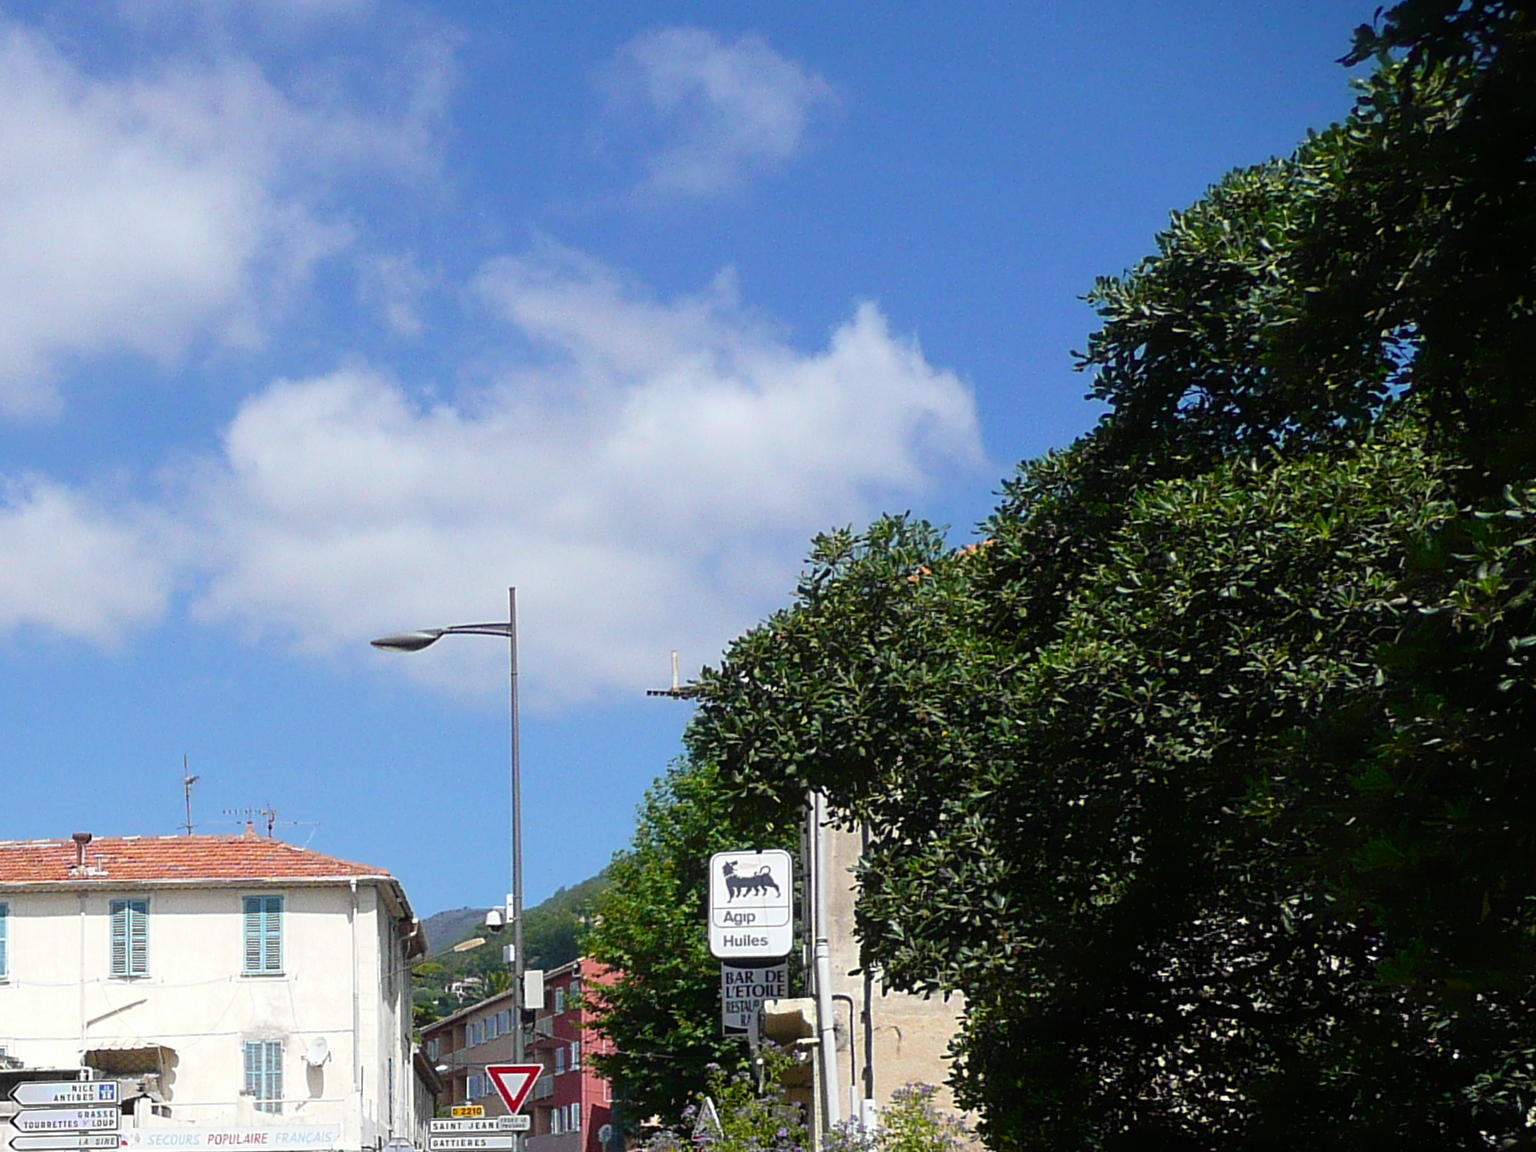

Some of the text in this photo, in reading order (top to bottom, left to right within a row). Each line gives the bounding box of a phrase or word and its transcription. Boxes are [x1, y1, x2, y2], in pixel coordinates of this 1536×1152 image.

[723, 911, 756, 925] Agip
[723, 934, 769, 947] Huiles
[725, 970, 785, 985] BAR DE
[726, 984, 785, 999] L'ETOILE
[72, 1084, 95, 1093] NICE
[53, 1094, 95, 1102] ANTIBES
[77, 1110, 115, 1118] GRASSE
[461, 1107, 482, 1116] 2210
[24, 1120, 79, 1129] TOURRETTES
[92, 1119, 115, 1128] LOUP
[432, 1122, 462, 1130] SAINT
[95, 1137, 116, 1146] SINE
[147, 1131, 333, 1146] SECOURS POPULAIRE FRANÇAIS
[432, 1138, 487, 1147] GATTIERES
